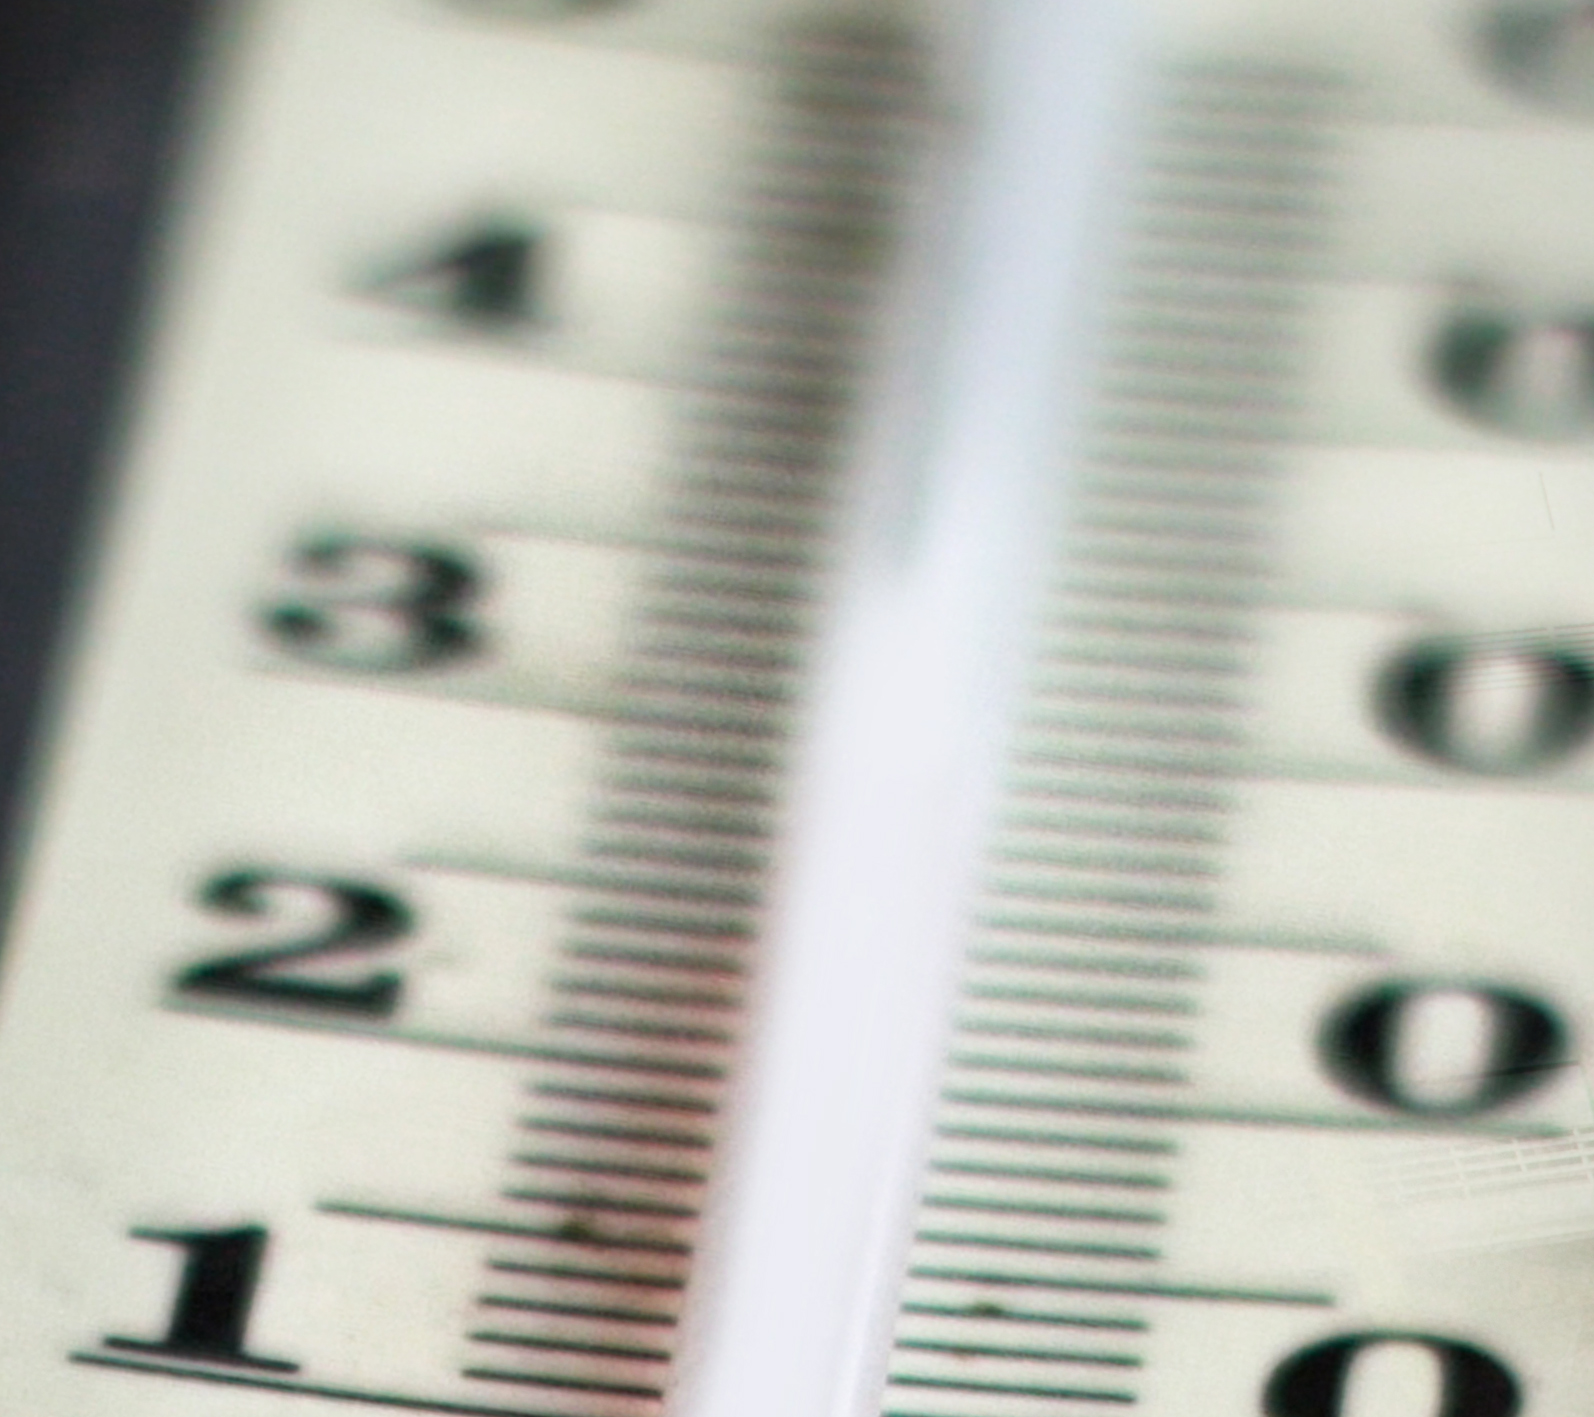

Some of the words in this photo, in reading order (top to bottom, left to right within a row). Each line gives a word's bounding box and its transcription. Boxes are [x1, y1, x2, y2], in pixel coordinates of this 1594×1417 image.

[255, 525, 490, 680] 3
[165, 865, 416, 1023] 2
[102, 1224, 300, 1376] 1
